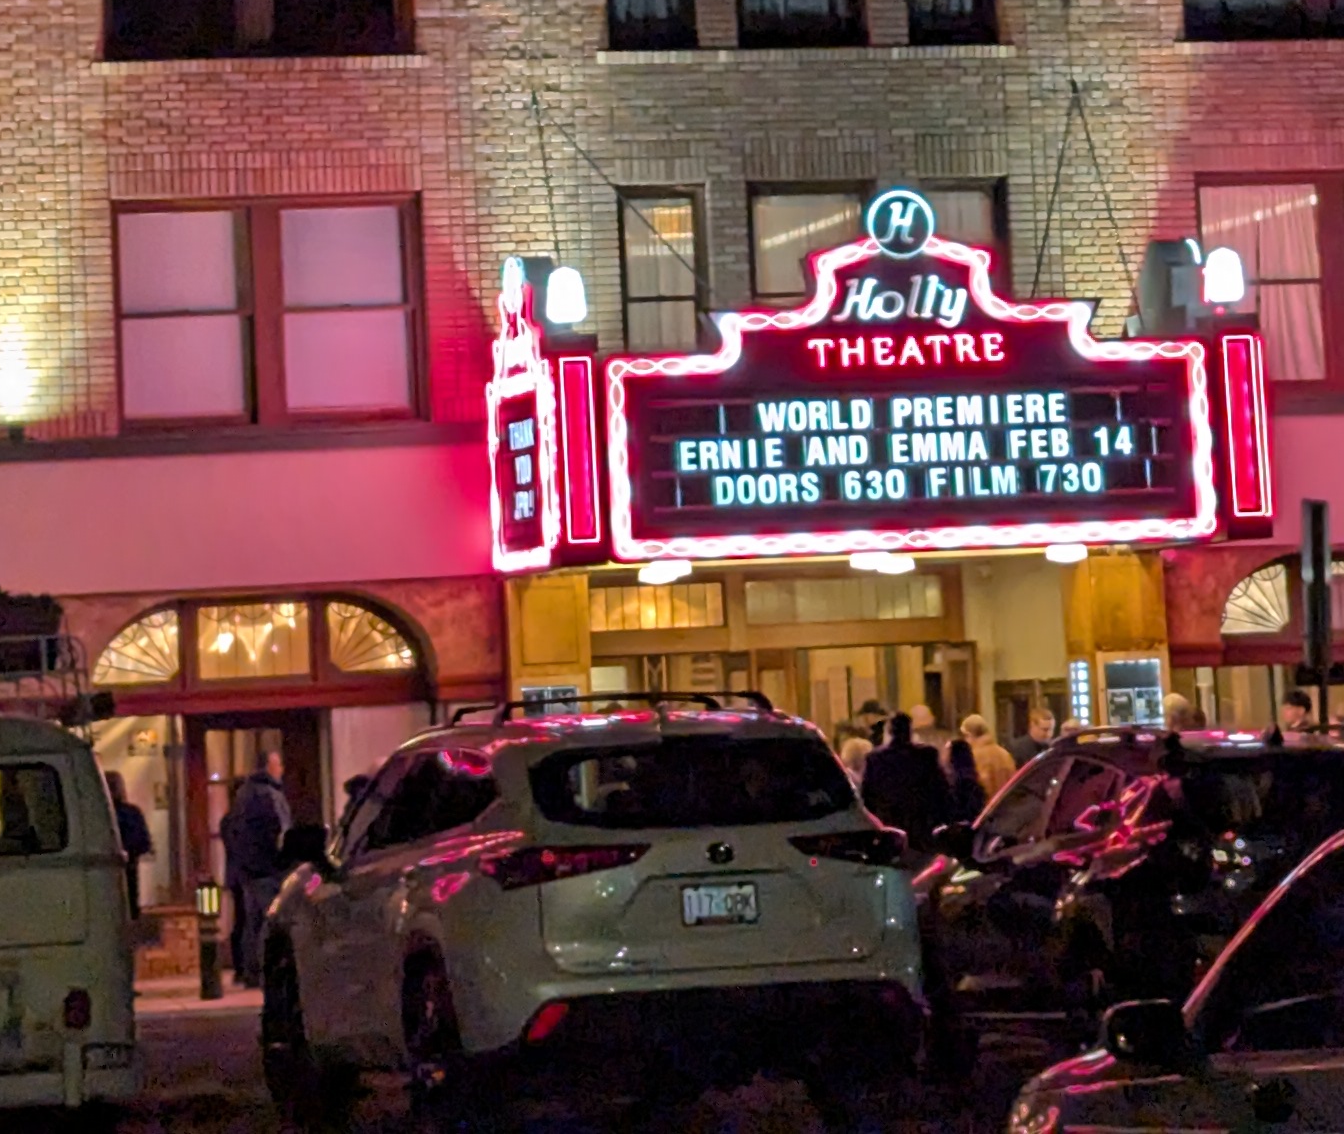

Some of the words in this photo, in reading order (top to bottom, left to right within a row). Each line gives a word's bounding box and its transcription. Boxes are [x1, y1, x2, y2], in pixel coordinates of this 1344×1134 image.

[876, 201, 917, 244] H
[833, 274, 968, 328] Holly
[807, 333, 1005, 368] THEATRE
[758, 399, 872, 432] WORLD
[892, 393, 1067, 426] PREMIERE
[679, 439, 783, 472] ERNIE
[807, 437, 869, 468] AND
[891, 432, 989, 464] EMMA
[1009, 429, 1071, 460] FEB
[1094, 425, 1133, 456] 14
[715, 473, 821, 507] DOORS
[844, 469, 906, 501] 630
[929, 467, 1019, 498] FILM
[1040, 461, 1102, 493] 730
